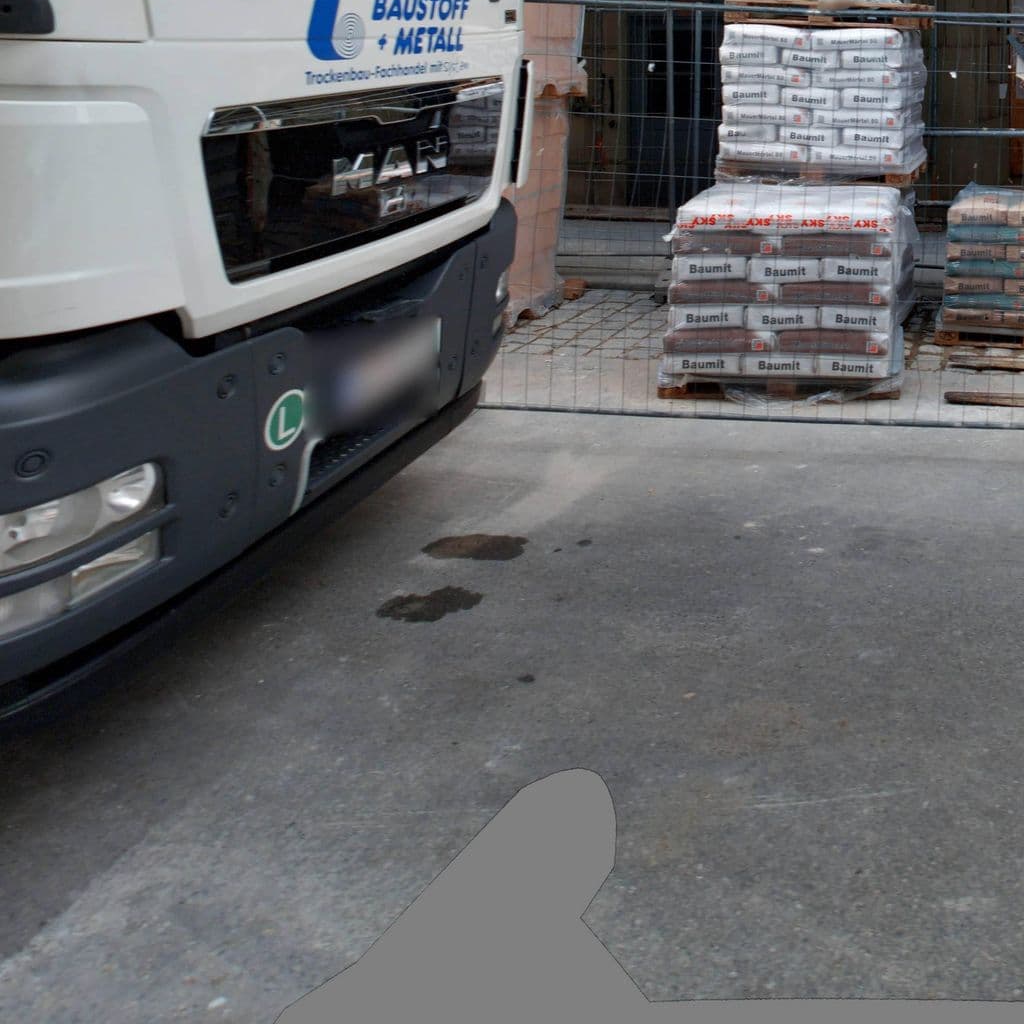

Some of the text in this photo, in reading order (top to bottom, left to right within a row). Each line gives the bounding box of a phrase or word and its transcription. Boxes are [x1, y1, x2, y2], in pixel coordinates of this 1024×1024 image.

[393, 27, 464, 56] METALL
[792, 54, 828, 64] Baumit
[305, 63, 428, 85] Trockenbau-Fachhandel
[792, 94, 827, 105] Baumit
[853, 95, 889, 104] Baumit
[790, 132, 825, 142] Baumit
[854, 133, 890, 144] Baumit
[332, 136, 448, 196] MAN
[691, 216, 717, 226] SKY
[746, 217, 771, 227] SKY
[801, 219, 825, 228] SKY
[854, 219, 878, 228] SKY
[689, 263, 732, 274] Baumit
[764, 266, 806, 277] Baumit
[837, 265, 879, 277] Baumit
[686, 312, 729, 323] Baumit
[762, 314, 804, 325] Baumit
[835, 314, 877, 326] Baumit
[682, 359, 725, 370] Baumit
[758, 360, 801, 371] Baumit
[832, 361, 874, 373] Baumit
[277, 406, 297, 441] L
